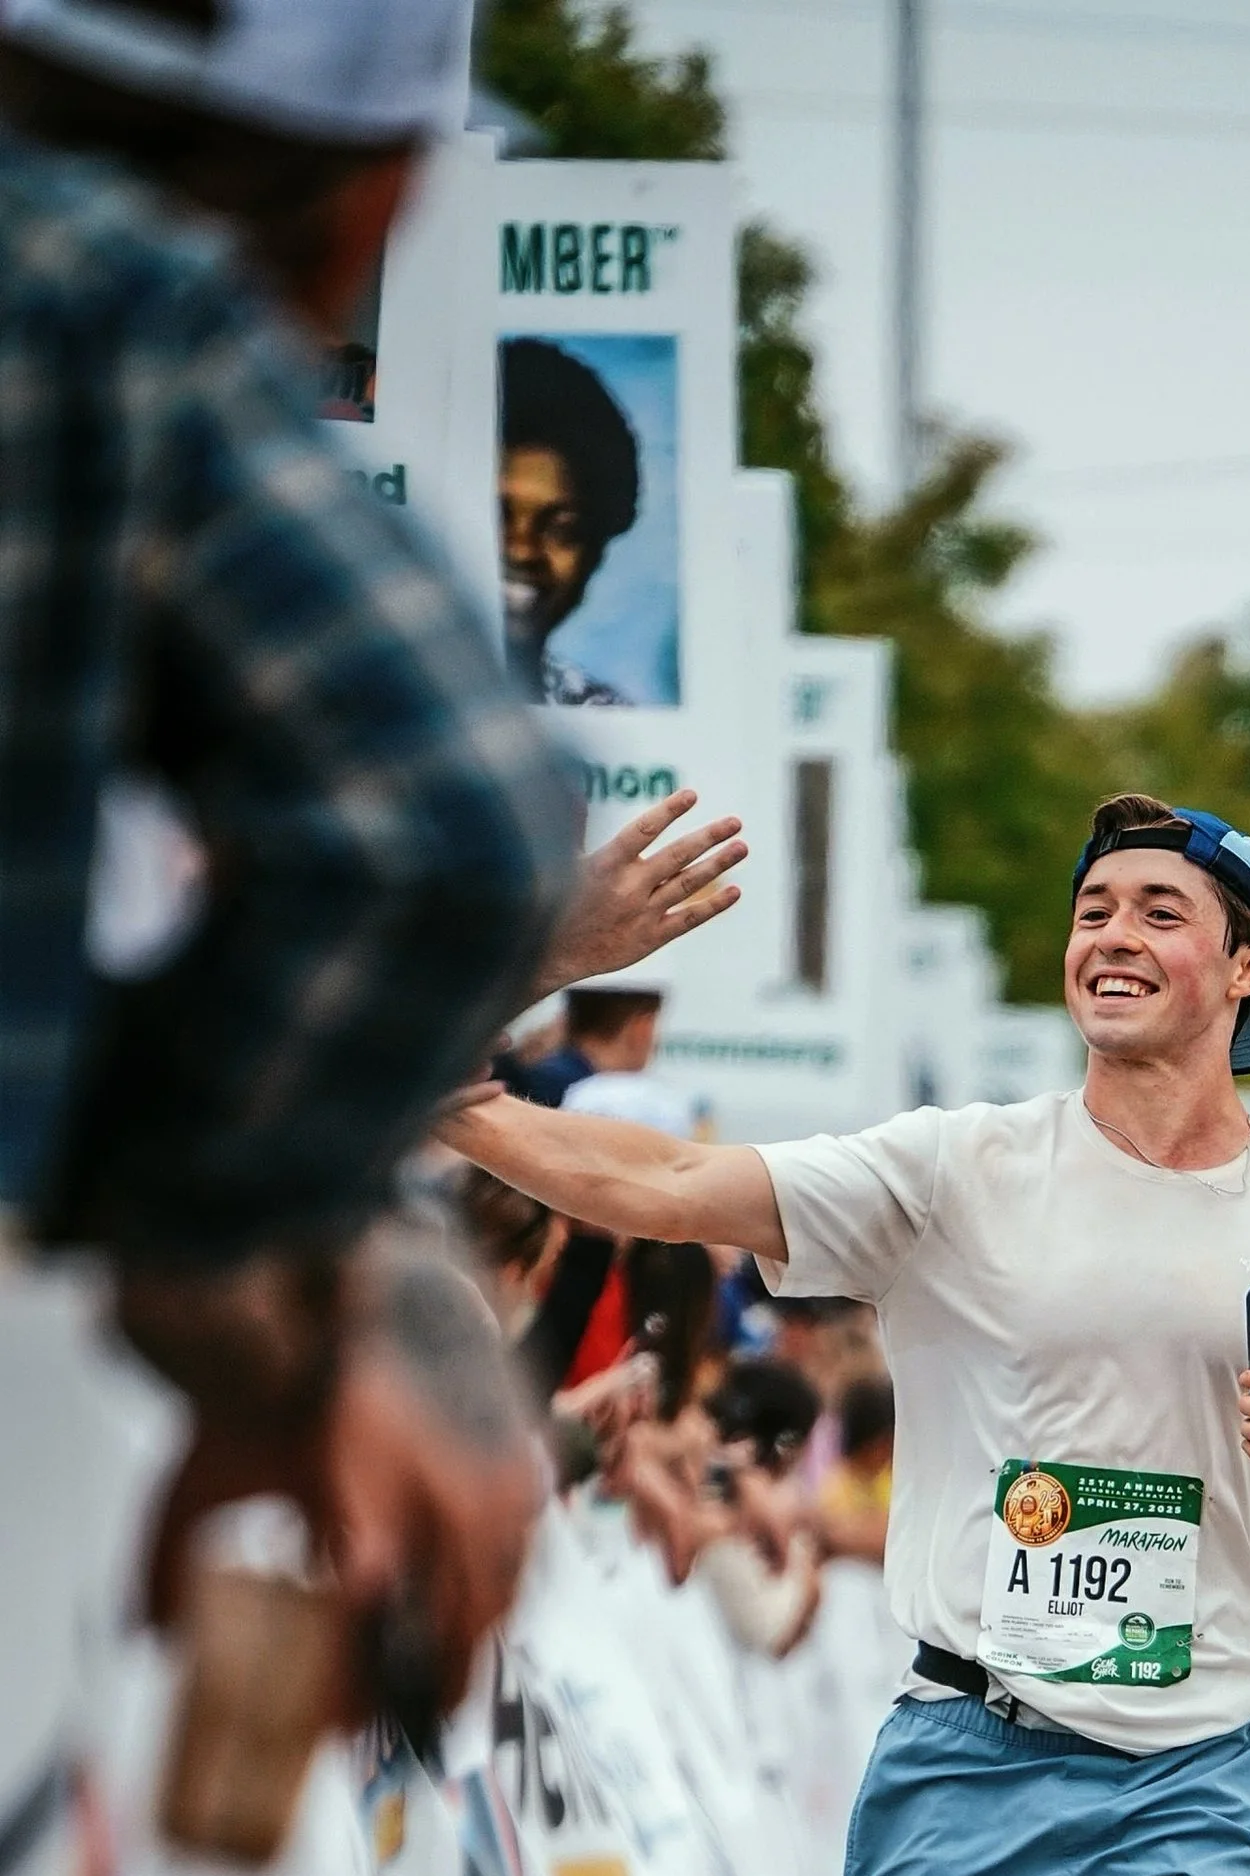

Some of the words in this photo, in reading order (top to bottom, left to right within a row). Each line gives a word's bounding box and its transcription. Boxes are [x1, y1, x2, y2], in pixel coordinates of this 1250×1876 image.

[1078, 1486, 1126, 1496] MEMORIAL
[1132, 1492, 1182, 1500] MARATHON
[1079, 1477, 1115, 1488] 25TH
[1124, 1482, 1182, 1494] ANNUAL
[1077, 1497, 1118, 1509] APRIL
[1123, 1501, 1144, 1512] 27,
[1148, 1504, 1182, 1514] 2025
[1098, 1528, 1188, 1552] MARATHON
[1007, 1549, 1030, 1594] A
[1050, 1552, 1132, 1604] 1192
[1048, 1600, 1085, 1617] ELLIOT
[1130, 1661, 1161, 1680] 1192
